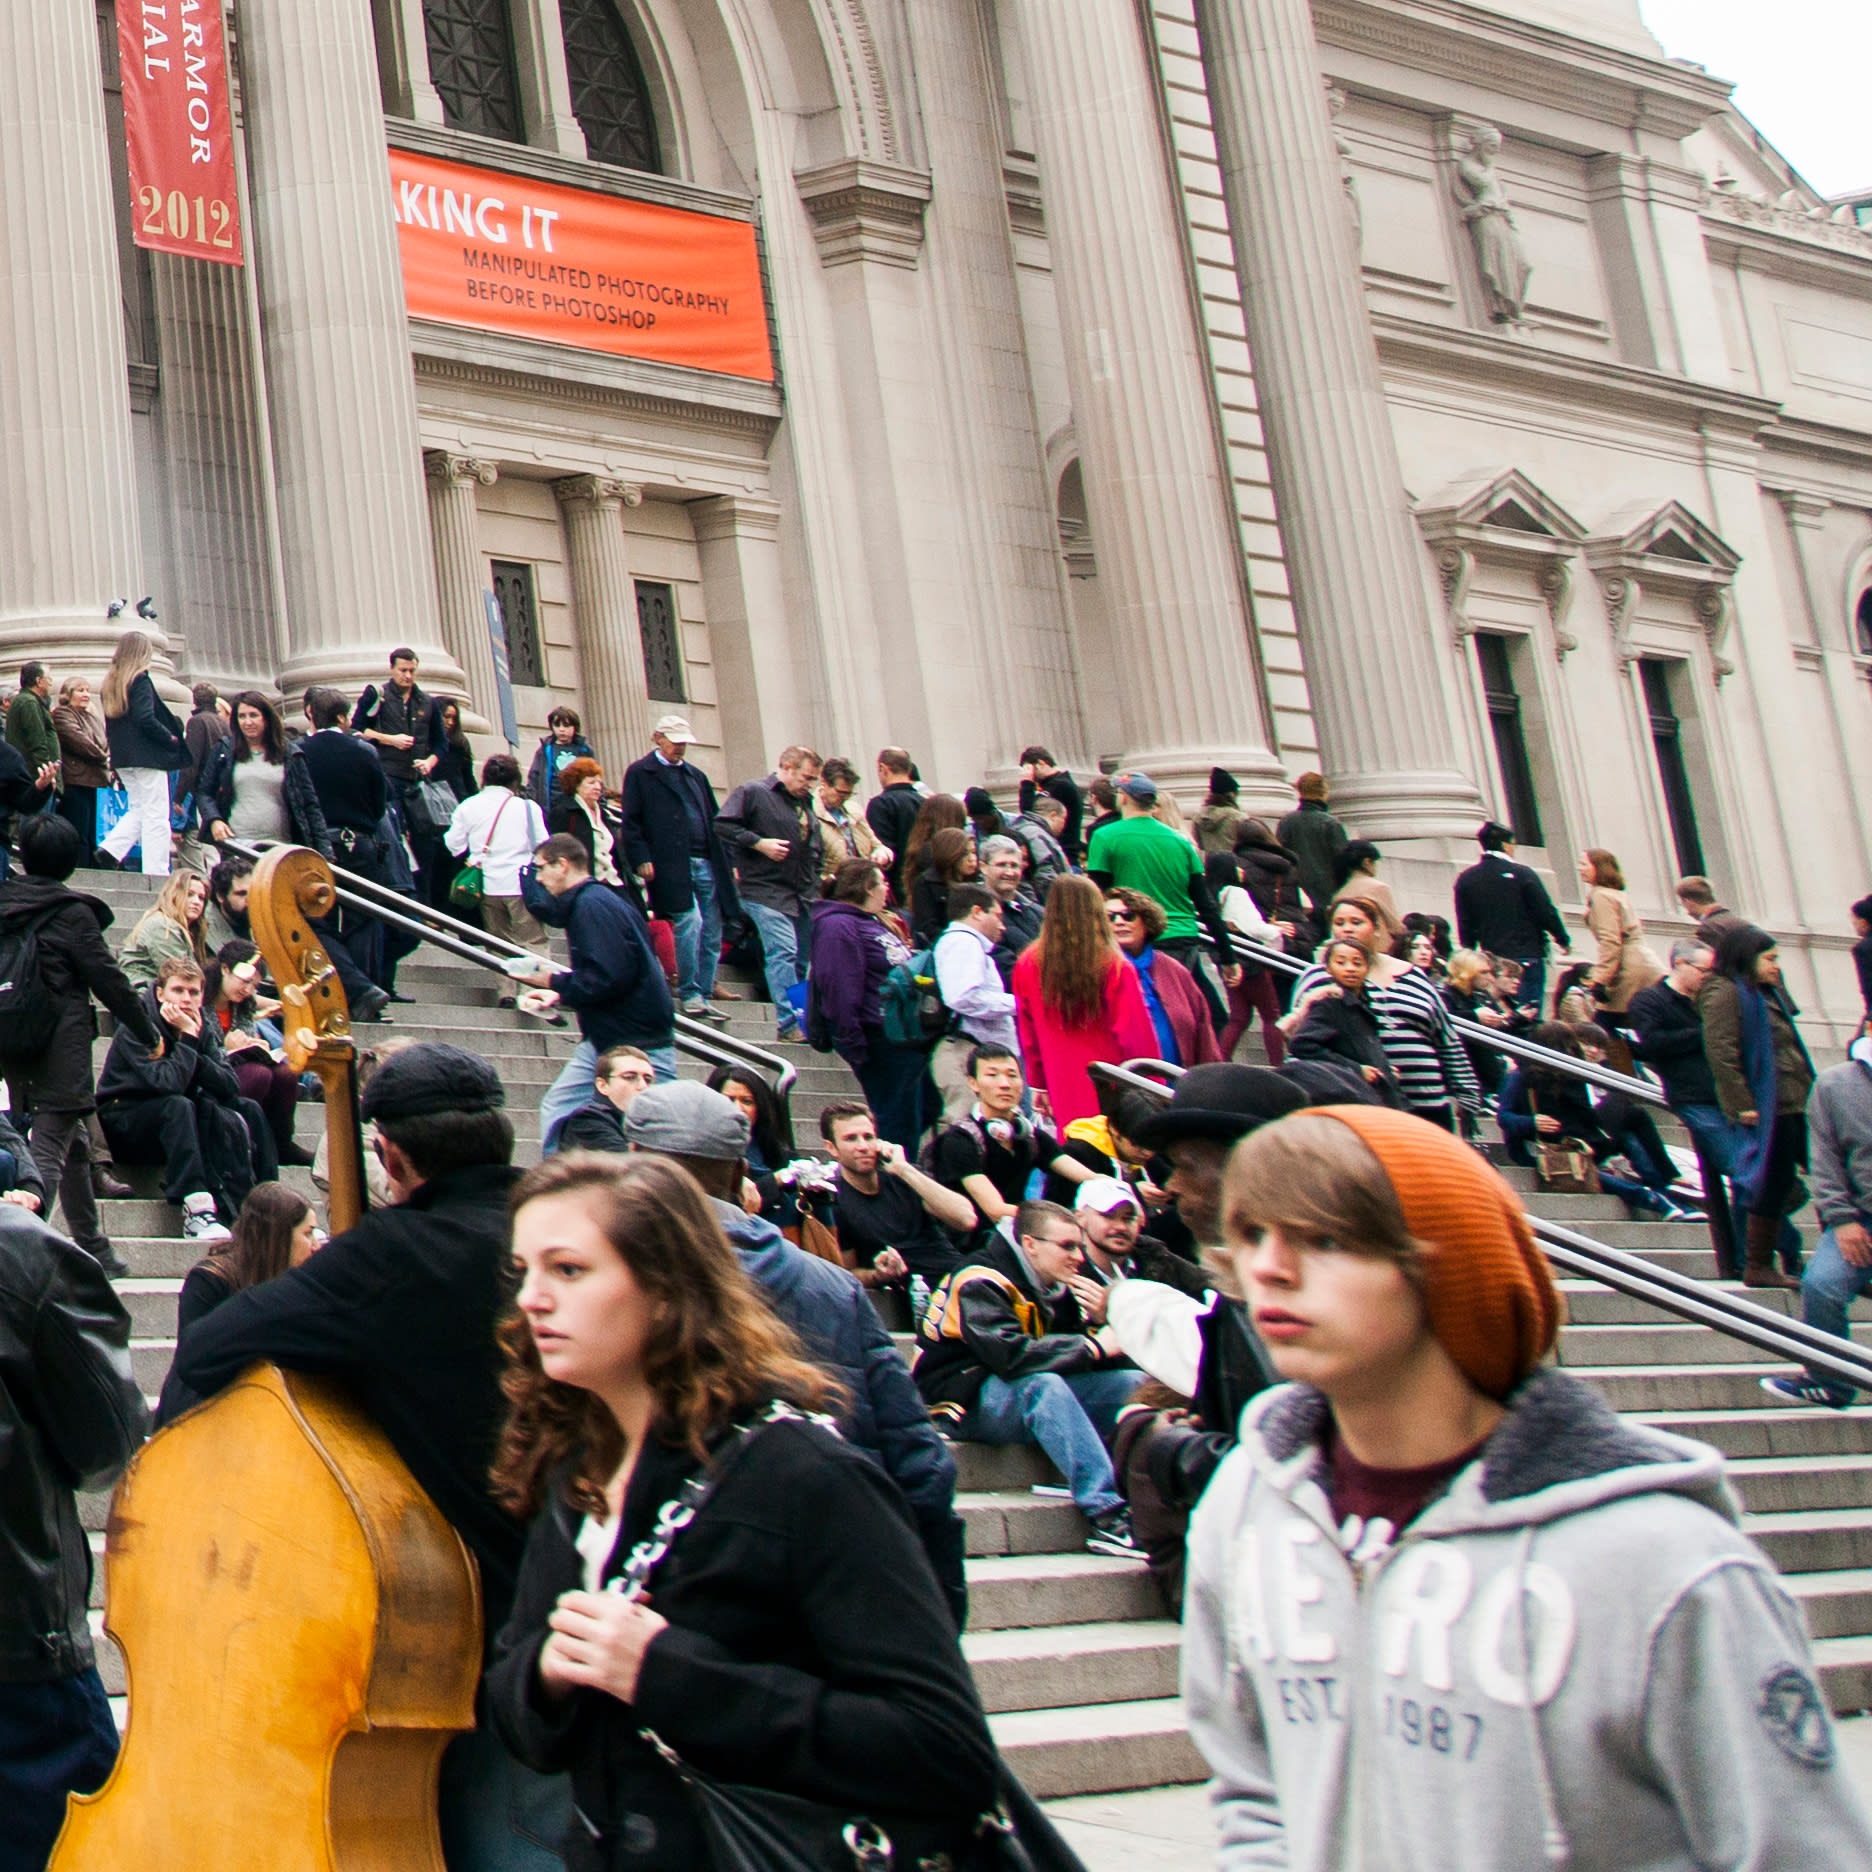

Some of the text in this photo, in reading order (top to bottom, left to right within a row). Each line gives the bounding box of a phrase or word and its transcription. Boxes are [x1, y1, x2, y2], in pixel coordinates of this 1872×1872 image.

[135, 185, 234, 250] 2012
[393, 180, 560, 253] KING IT
[463, 247, 729, 316] MANIPULATED PHOTOGRAPHY
[467, 278, 656, 330] BEFORE PHOTOSHOP
[1384, 1694, 1485, 1763] 1987
